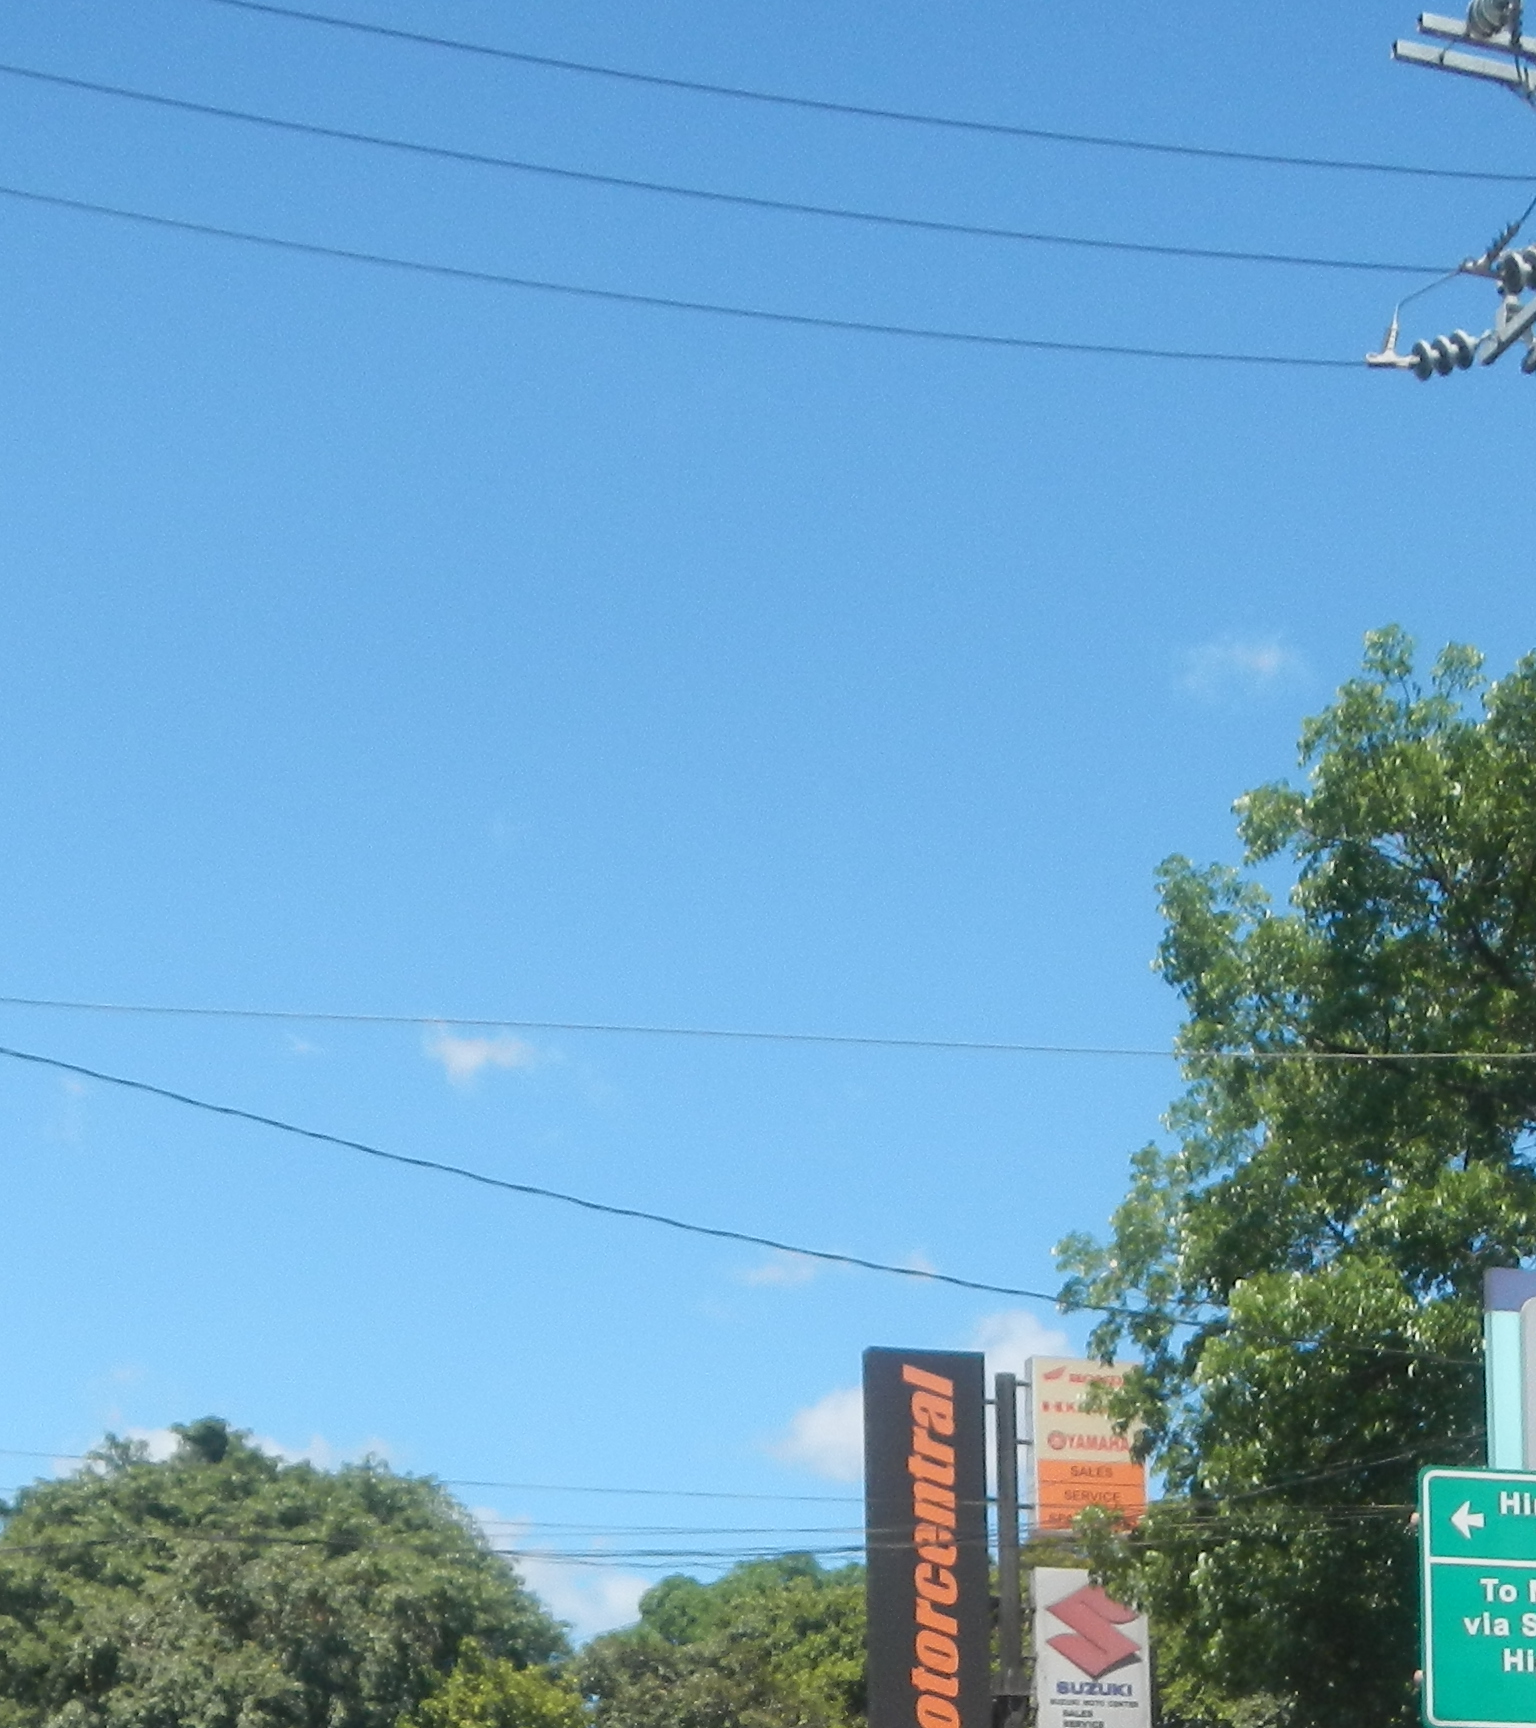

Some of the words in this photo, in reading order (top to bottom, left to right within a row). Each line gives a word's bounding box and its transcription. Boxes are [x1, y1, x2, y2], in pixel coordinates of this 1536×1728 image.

[1067, 1433, 1129, 1452] YAMAHA
[1070, 1466, 1113, 1479] SALES
[1064, 1489, 1122, 1503] SERVICE
[1480, 1578, 1517, 1603] To
[1464, 1612, 1510, 1637] via
[1056, 1681, 1133, 1697] SUZUKI
